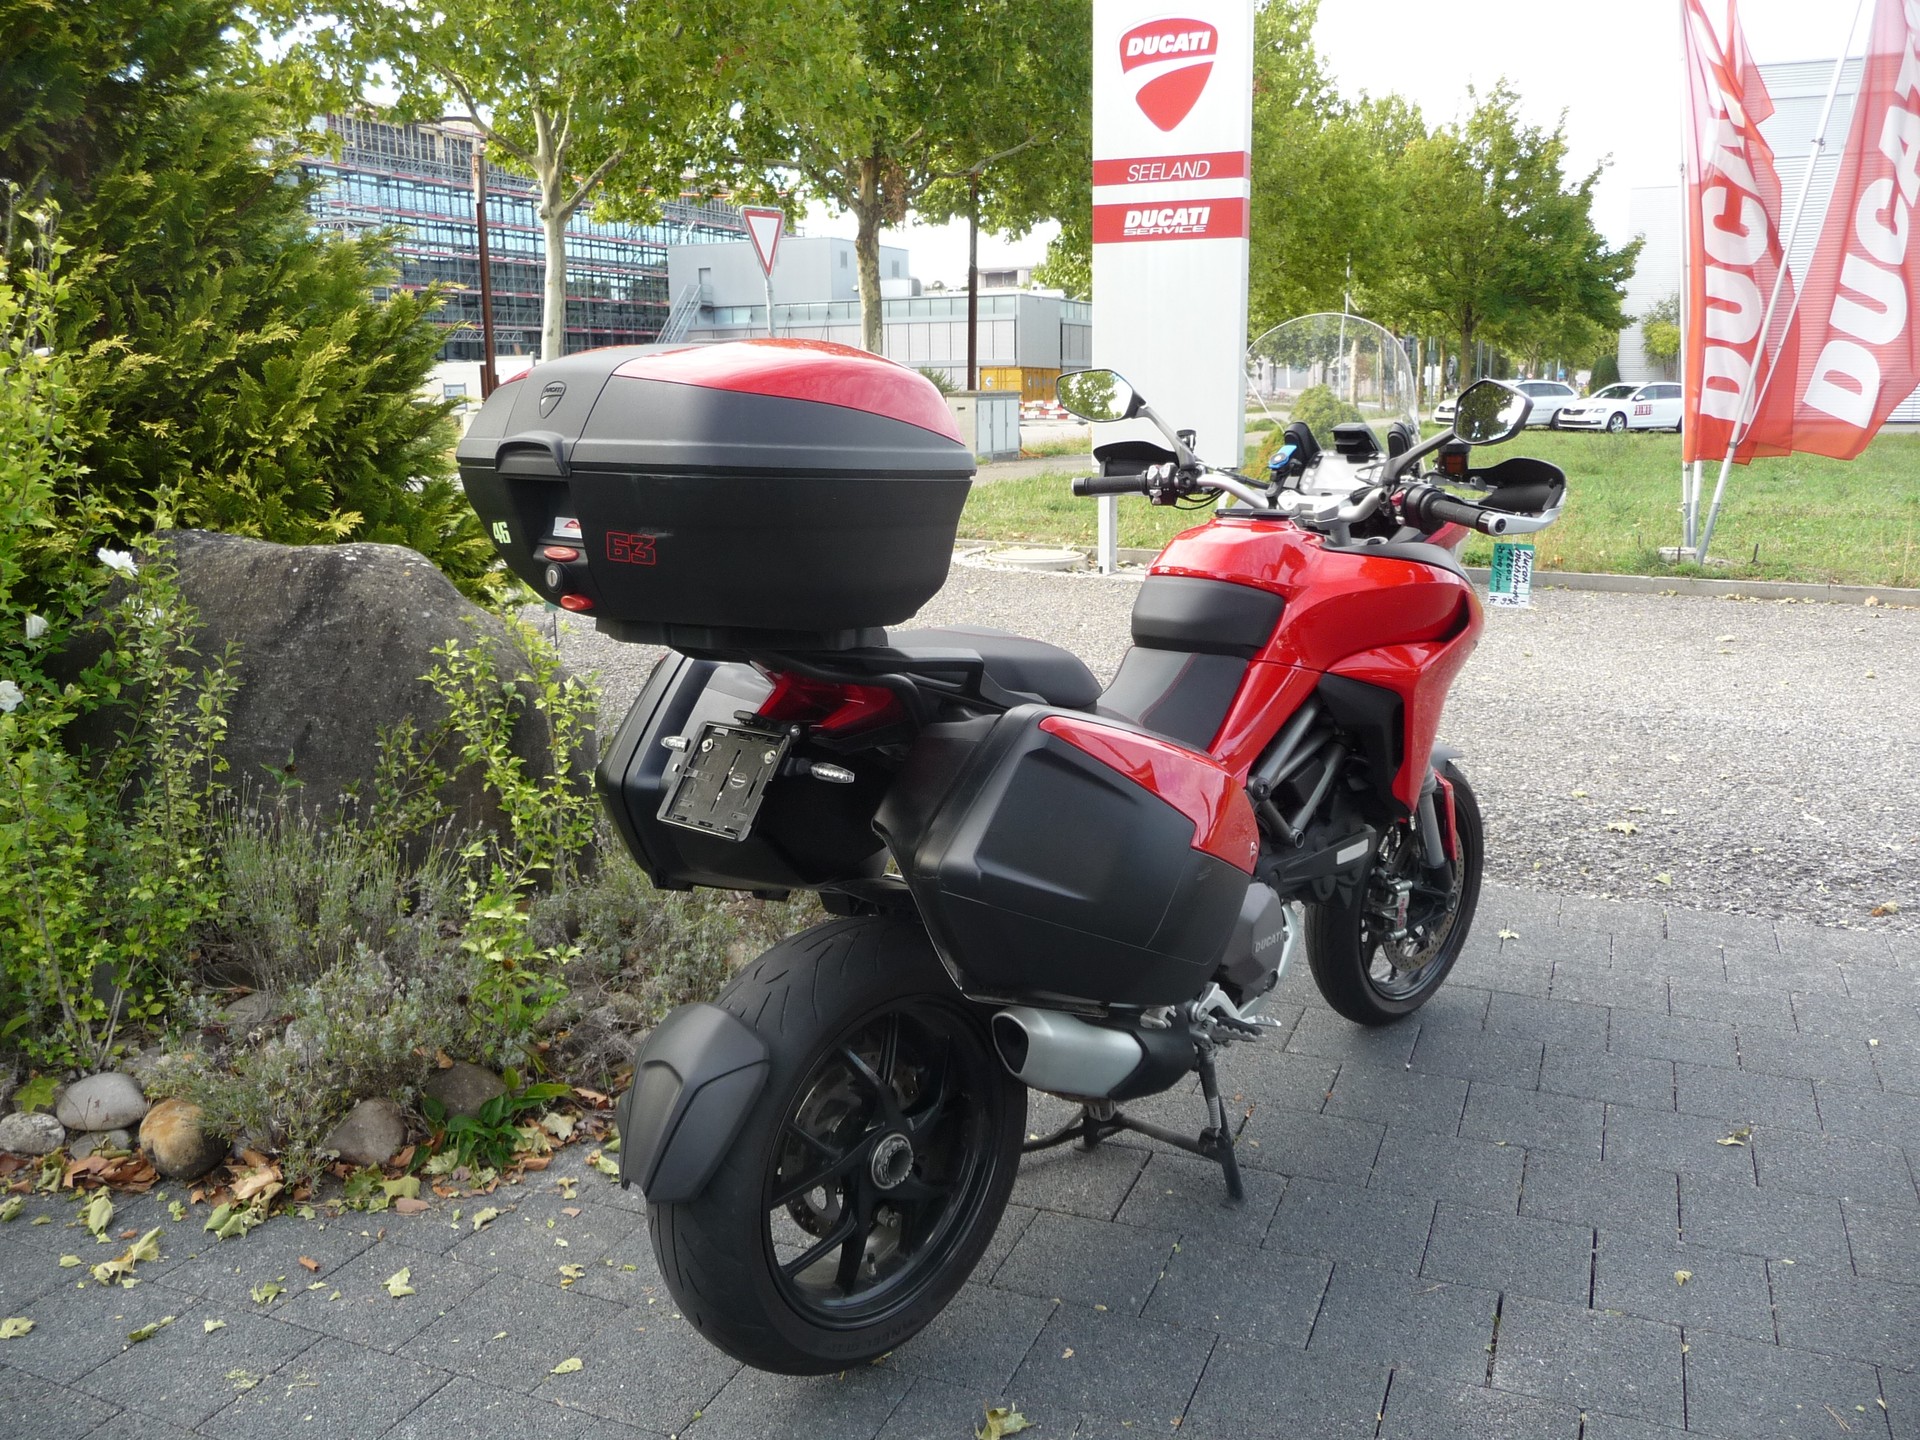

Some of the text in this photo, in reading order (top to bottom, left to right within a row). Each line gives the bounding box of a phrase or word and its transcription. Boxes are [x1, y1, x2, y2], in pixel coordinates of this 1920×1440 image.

[1126, 31, 1211, 57] DUCATI
[1127, 160, 1210, 183] SEELAND
[1124, 206, 1211, 228] DUCATI
[1123, 224, 1206, 236] SERVICE
[492, 521, 511, 544] 46
[606, 530, 656, 565] 63
[1255, 930, 1283, 953] DUCATI
